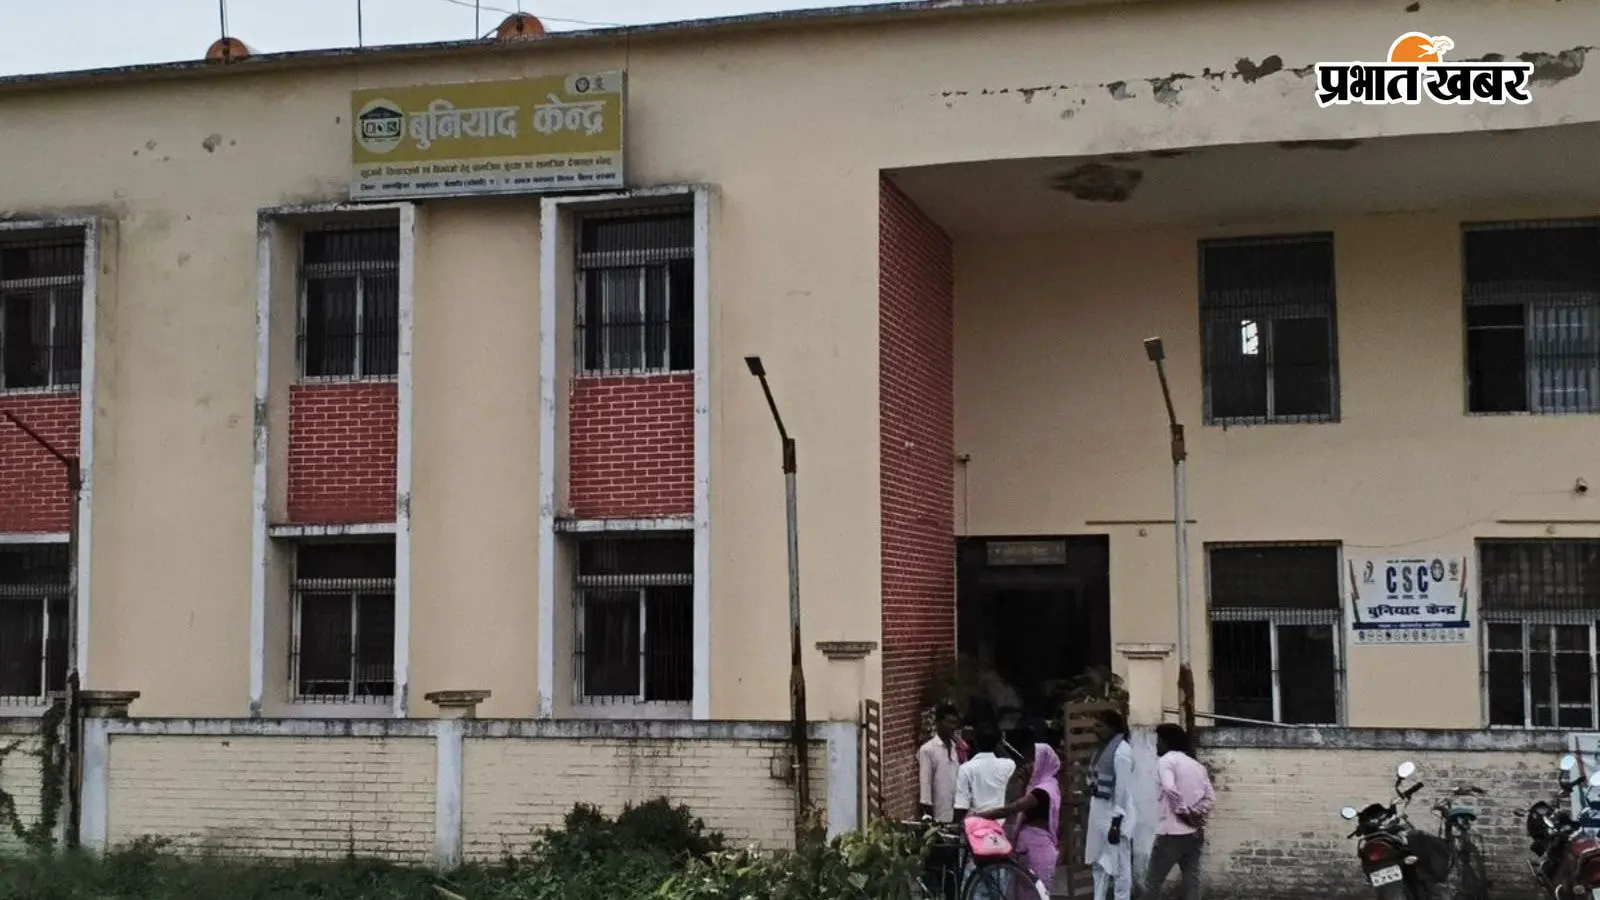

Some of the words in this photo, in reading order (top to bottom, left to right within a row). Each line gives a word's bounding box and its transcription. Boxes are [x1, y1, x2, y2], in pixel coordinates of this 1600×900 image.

[409, 99, 520, 150] बुनियाद
[534, 94, 607, 136] केन्द्र
[1386, 566, 1428, 593] CSC
[1367, 604, 1420, 618] बुनियाद
